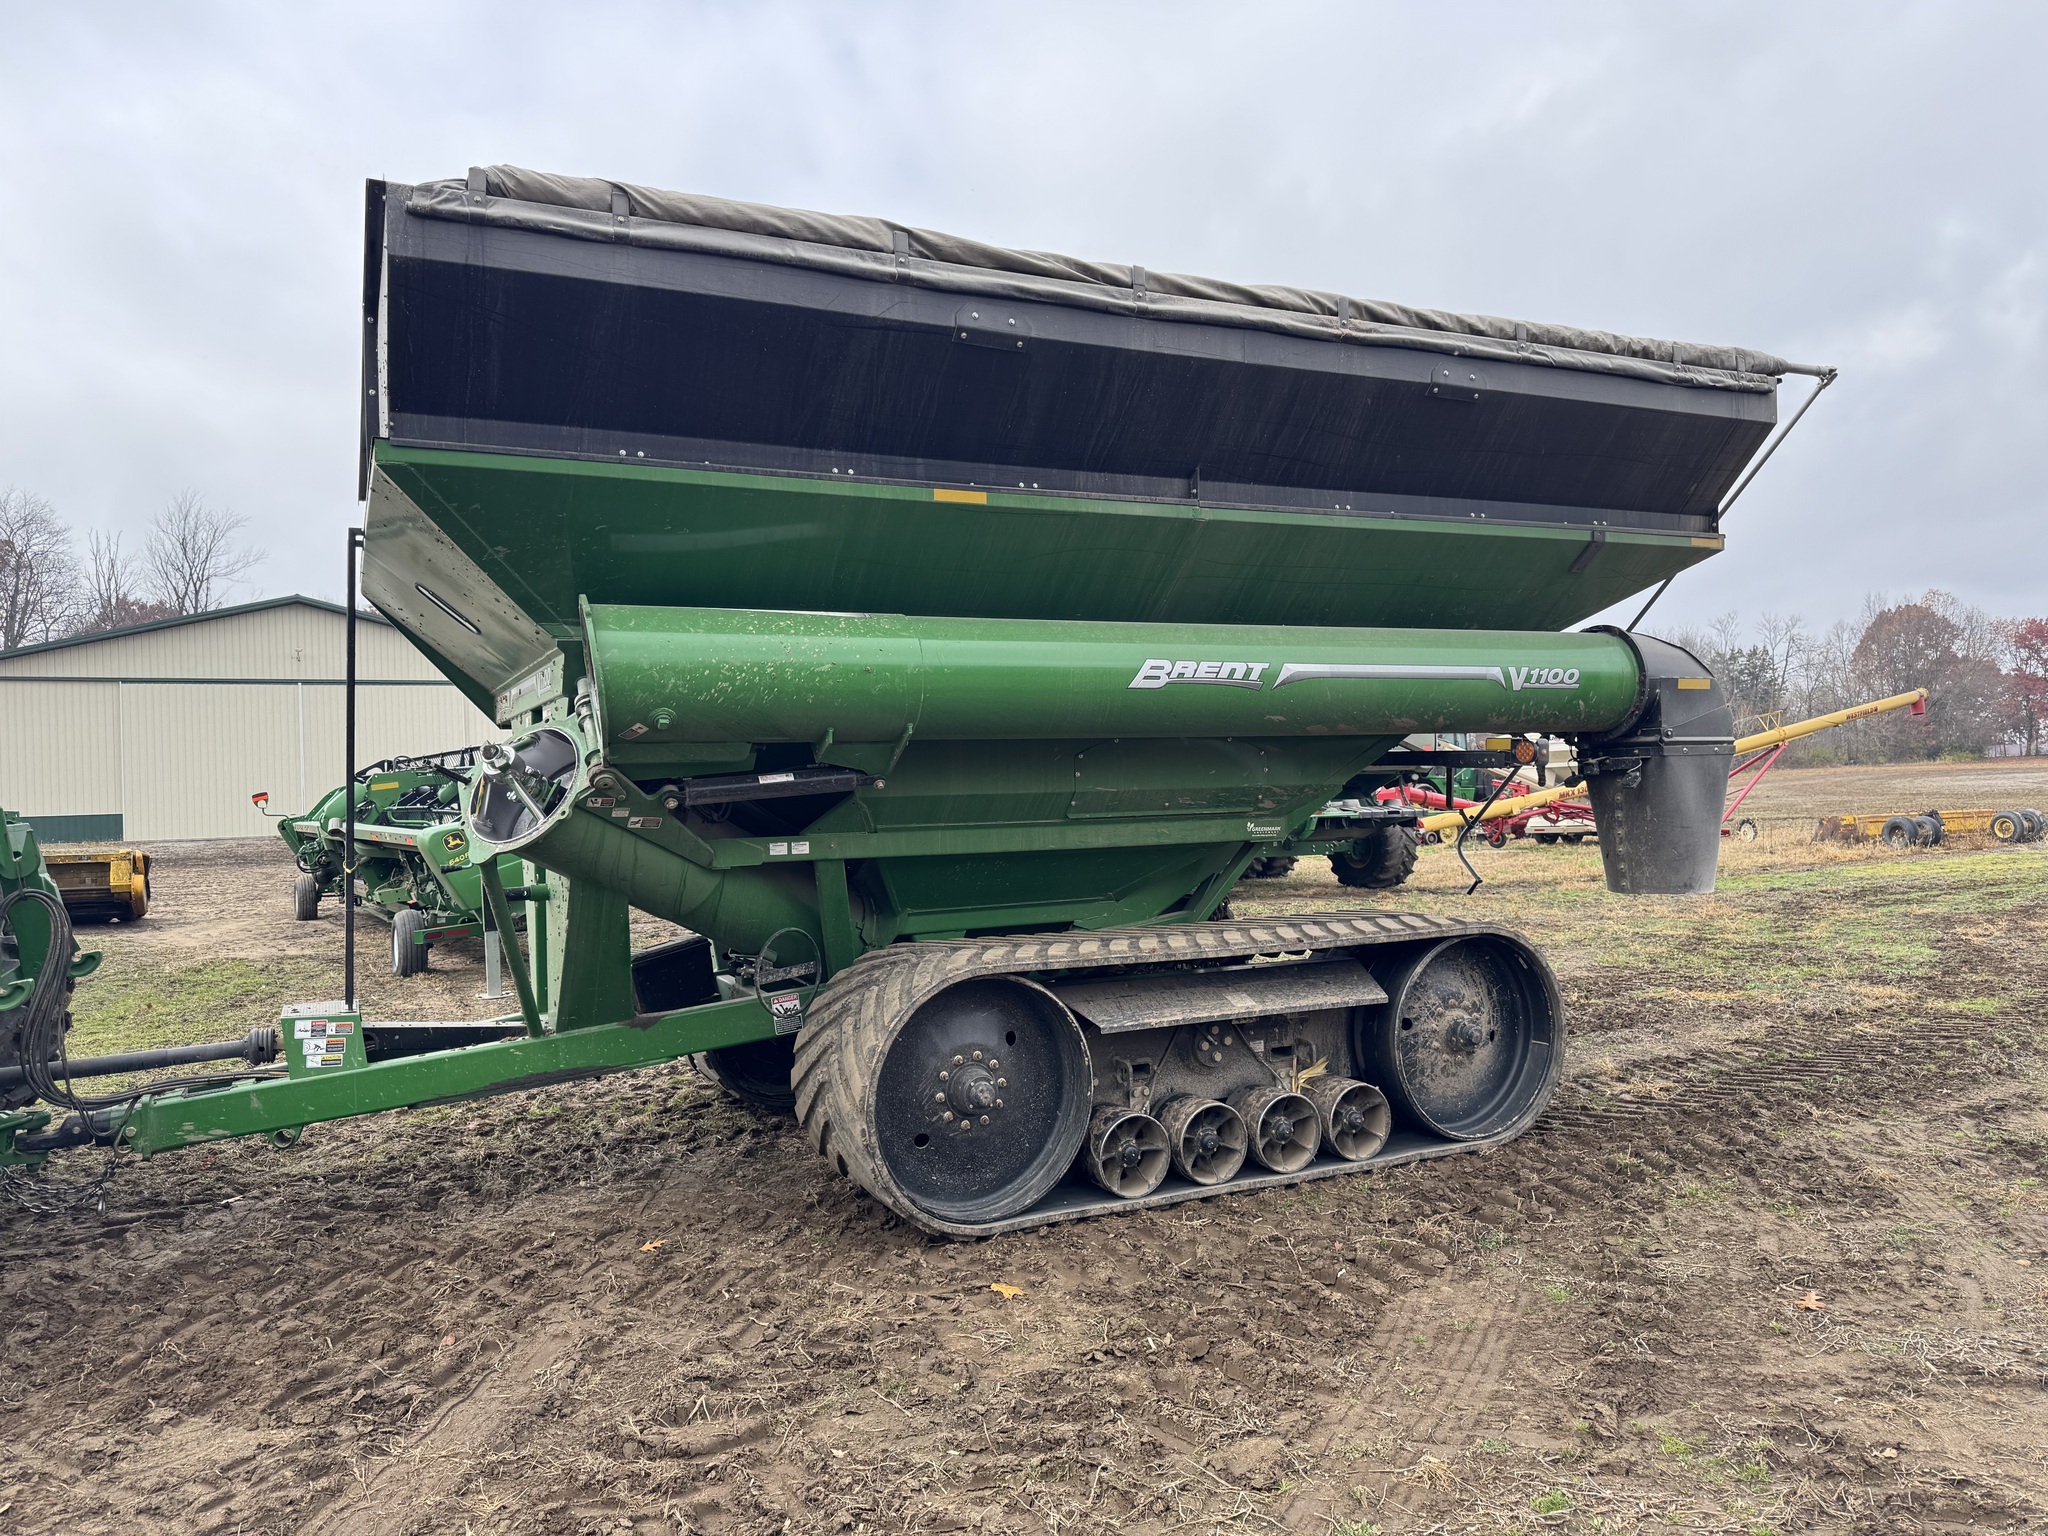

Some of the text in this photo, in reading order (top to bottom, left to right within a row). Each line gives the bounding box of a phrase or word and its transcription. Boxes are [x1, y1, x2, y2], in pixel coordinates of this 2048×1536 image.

[1127, 658, 1580, 692] BRENT V1100
[1846, 708, 1874, 721] WESTFIELD
[1558, 789, 1576, 799] MKX
[778, 994, 798, 1003] DANGER
